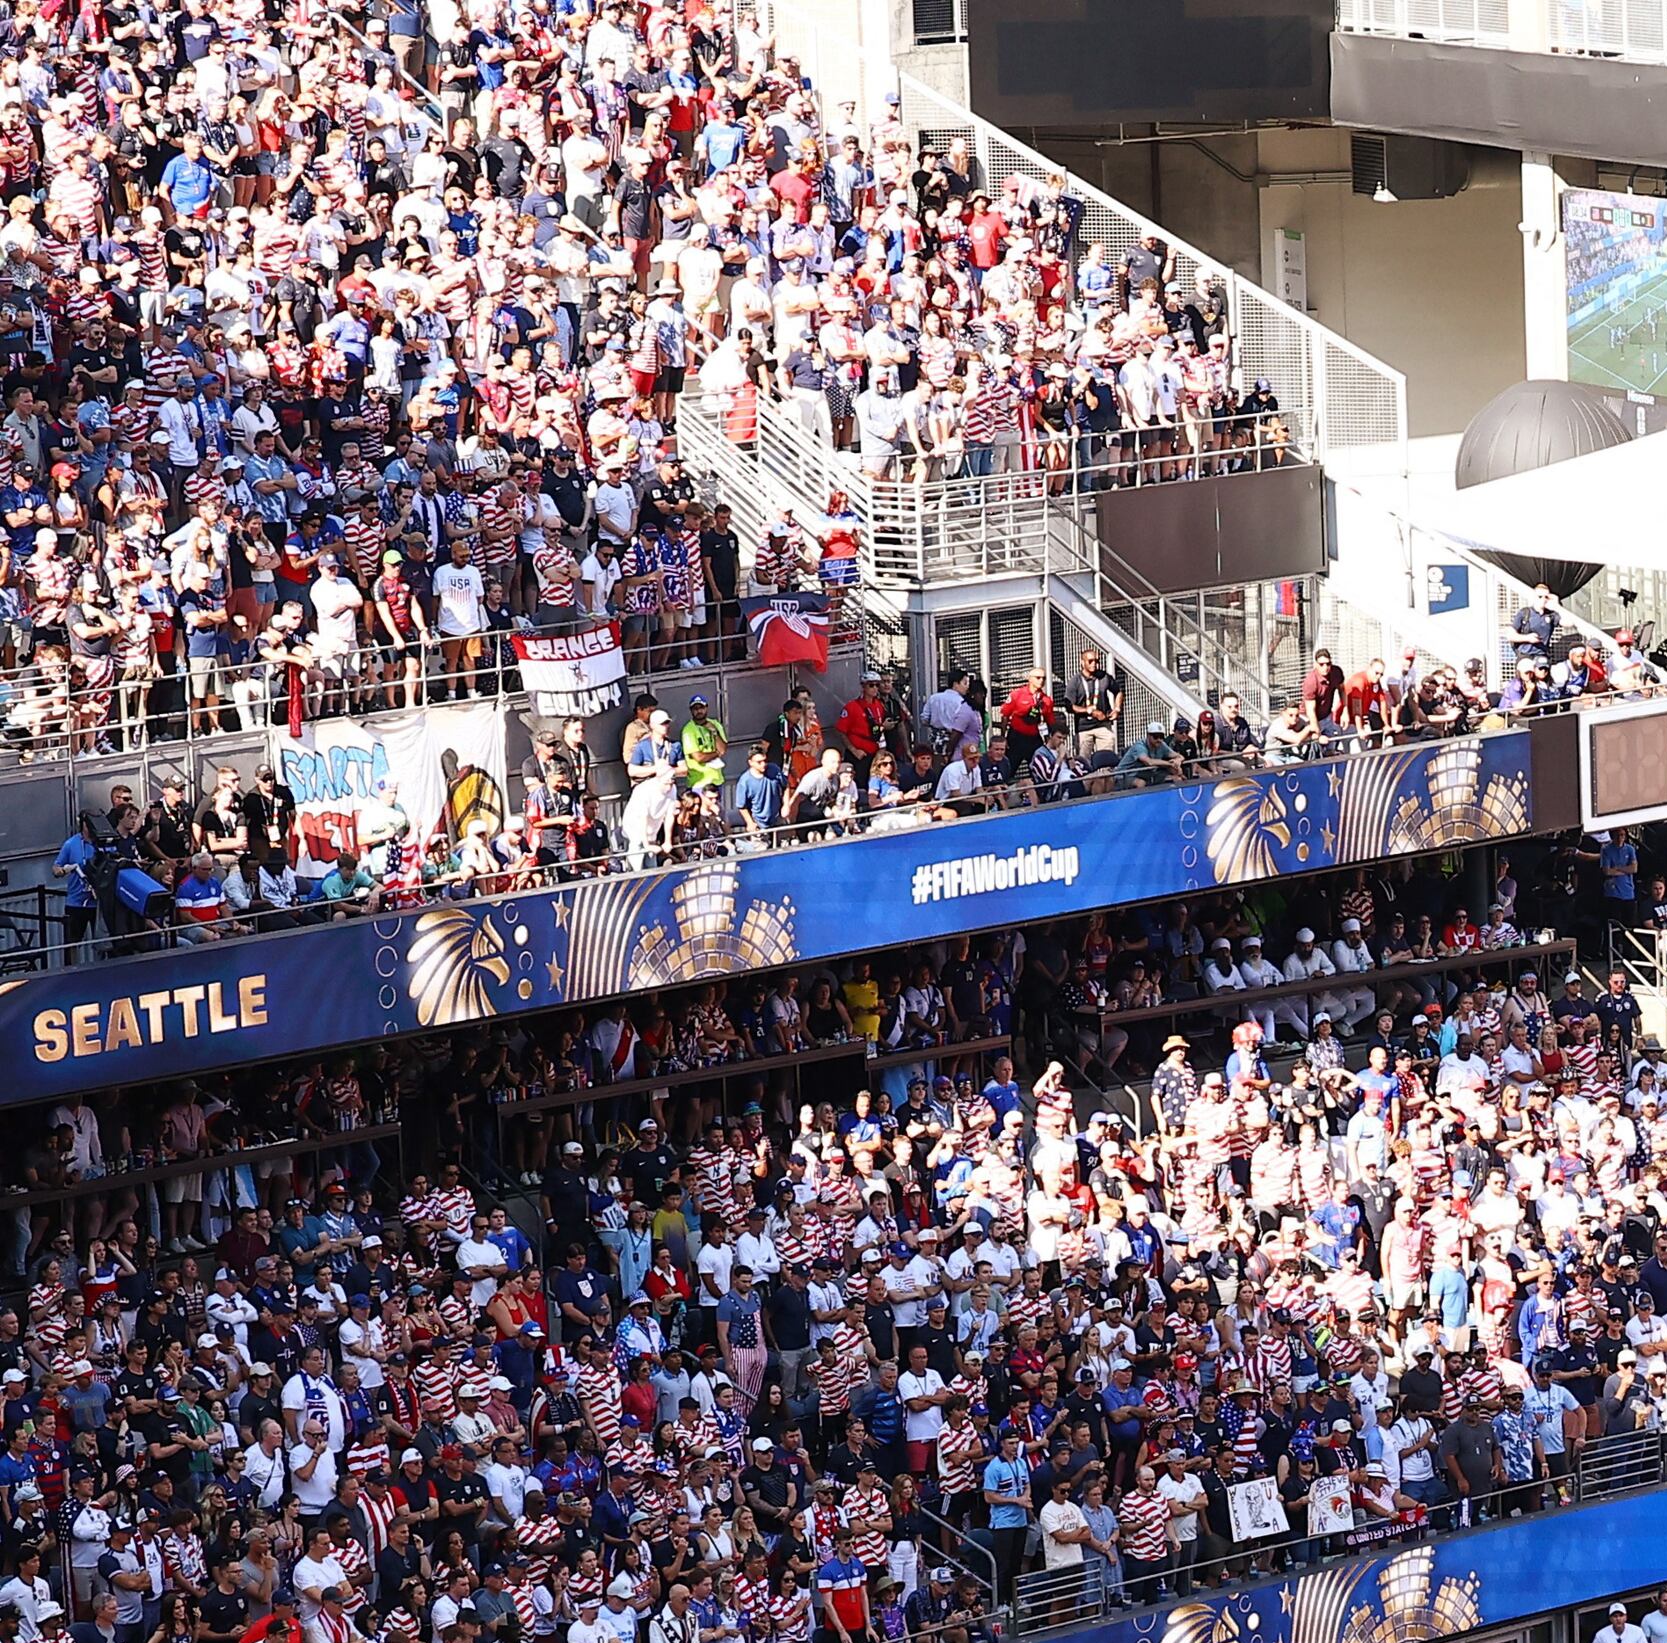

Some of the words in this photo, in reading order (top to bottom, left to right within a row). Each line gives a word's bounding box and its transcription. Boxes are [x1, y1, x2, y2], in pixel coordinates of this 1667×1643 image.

[450, 578, 471, 590] USA
[524, 626, 615, 661] ORANGE
[535, 682, 622, 718] COUNTY
[911, 843, 1080, 906] #FIFAWorldCup
[33, 973, 269, 1063] SEATTLE
[1355, 1527, 1384, 1543] UNITED
